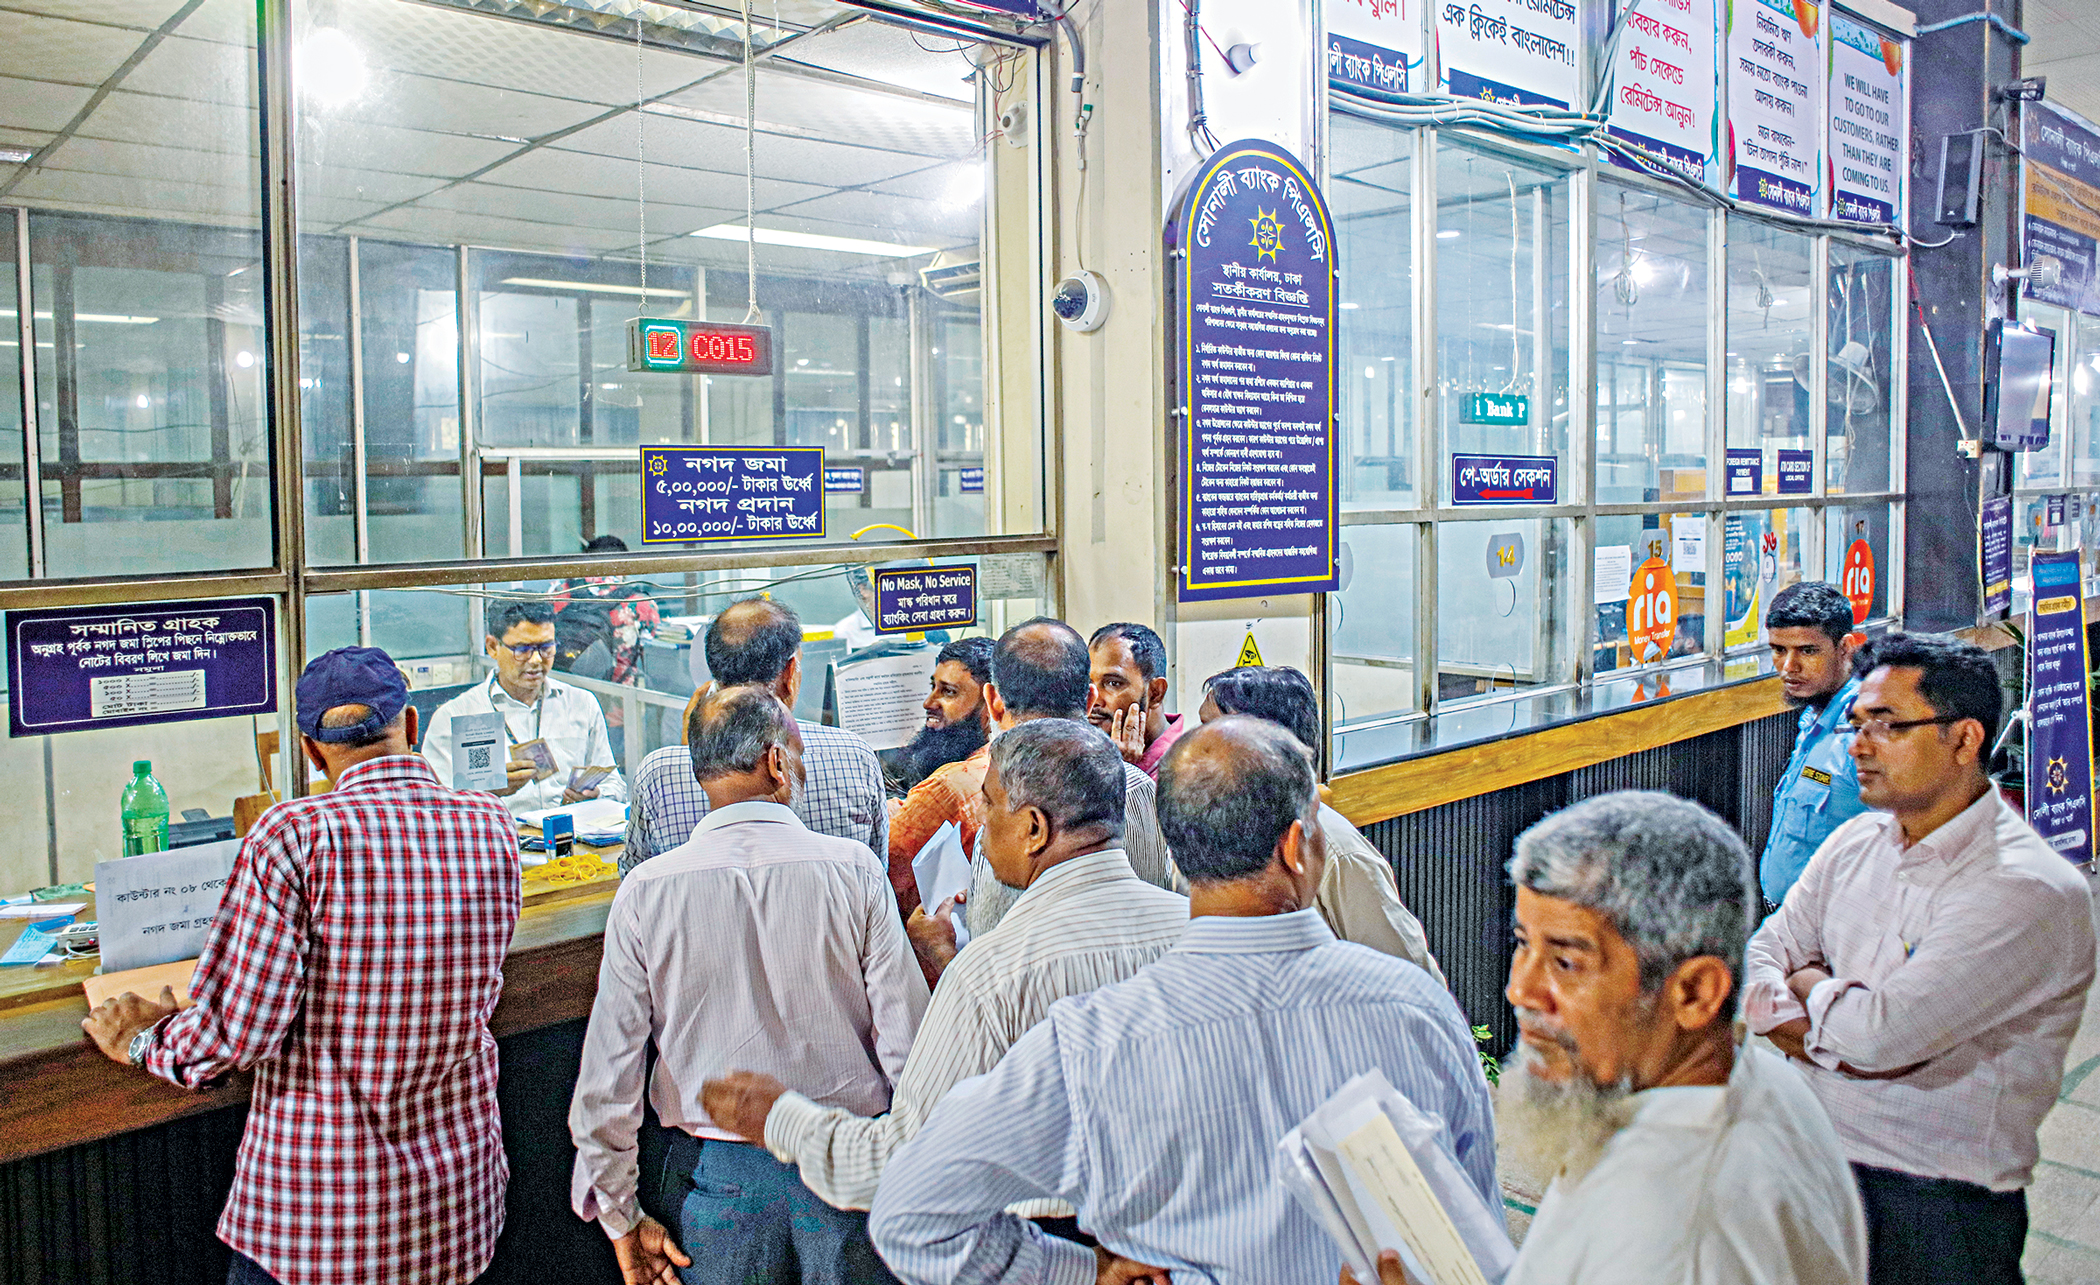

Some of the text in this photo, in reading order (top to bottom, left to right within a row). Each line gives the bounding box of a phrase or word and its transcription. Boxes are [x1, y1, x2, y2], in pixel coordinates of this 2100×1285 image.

[1443, 4, 1575, 67] এক ক্লিকেই বাংলাদেশ!!
[1662, 23, 1692, 55] করুন,
[1756, 11, 1792, 44] নিয়মিত ঋণ
[1630, 46, 1648, 71] পাঁচ
[1776, 50, 1796, 72] করুন,
[1344, 54, 1372, 83] ব্যাংক
[1372, 53, 1406, 91] পিএলসি
[1739, 57, 1756, 77] সময়
[1772, 72, 1790, 91] ব্যাংক
[1790, 80, 1808, 99] পাওনা
[1844, 73, 1888, 104] WE WILL HAVE
[1621, 82, 1696, 129] রেমিটেন্স আনুন!
[1775, 97, 1795, 118] করুন।
[1844, 96, 1889, 126] TO GO TO OUR
[1834, 116, 1899, 152] CUSTOMERS, RATHER
[1842, 142, 1891, 172] THAN THEY ARE
[1842, 167, 1890, 193] COMING TO US.
[1196, 166, 1325, 263] সোনালী ব্যাংক পিএলসি
[1221, 262, 1302, 286] স্থানীয় কার্যালয়, ঢাকা
[1212, 280, 1309, 304] সতর্কীকরণ বিজ্ঞপ্তি
[648, 332, 753, 361] 12 C015
[1486, 400, 1514, 418] Bank
[1518, 402, 1525, 418] P
[683, 456, 788, 473] নগদ জমা
[1460, 461, 1551, 488] পে-অর্ডার সেকশন
[656, 476, 738, 495] ৫,০০,০০০/-
[742, 475, 778, 492] টাকার
[677, 496, 796, 514] নগদ প্রদান
[653, 516, 744, 538] ১০,০০,০০০/-
[746, 514, 782, 532] টাকার
[1496, 544, 1516, 567] 14
[1648, 540, 1662, 558] 15
[882, 573, 970, 592] No Mask, No Service
[1846, 551, 1870, 596] ria
[897, 593, 957, 608] মাস্ক পরিধান করে
[1634, 573, 1672, 632] ria
[69, 616, 220, 638] সম্মানিত গ্রাহক
[883, 608, 971, 626] ব্যাংকিং সেবা গ্রহণ করুন।
[31, 642, 65, 658] অনুগ্রহ
[67, 639, 92, 658] পূর্বক
[94, 640, 116, 652] নগদ
[120, 638, 140, 650] জমা
[141, 634, 173, 650] স্লিপের
[174, 632, 203, 648] পিছনে
[1634, 628, 1670, 645] Money Transfer
[78, 648, 218, 669] নোটের বিবরণ লিখে জমা দিন।
[116, 888, 160, 903] কাউন্টার
[163, 888, 176, 896] নং
[180, 884, 198, 894] ০৮
[142, 924, 166, 936] নগদ
[170, 921, 190, 932] জমা
